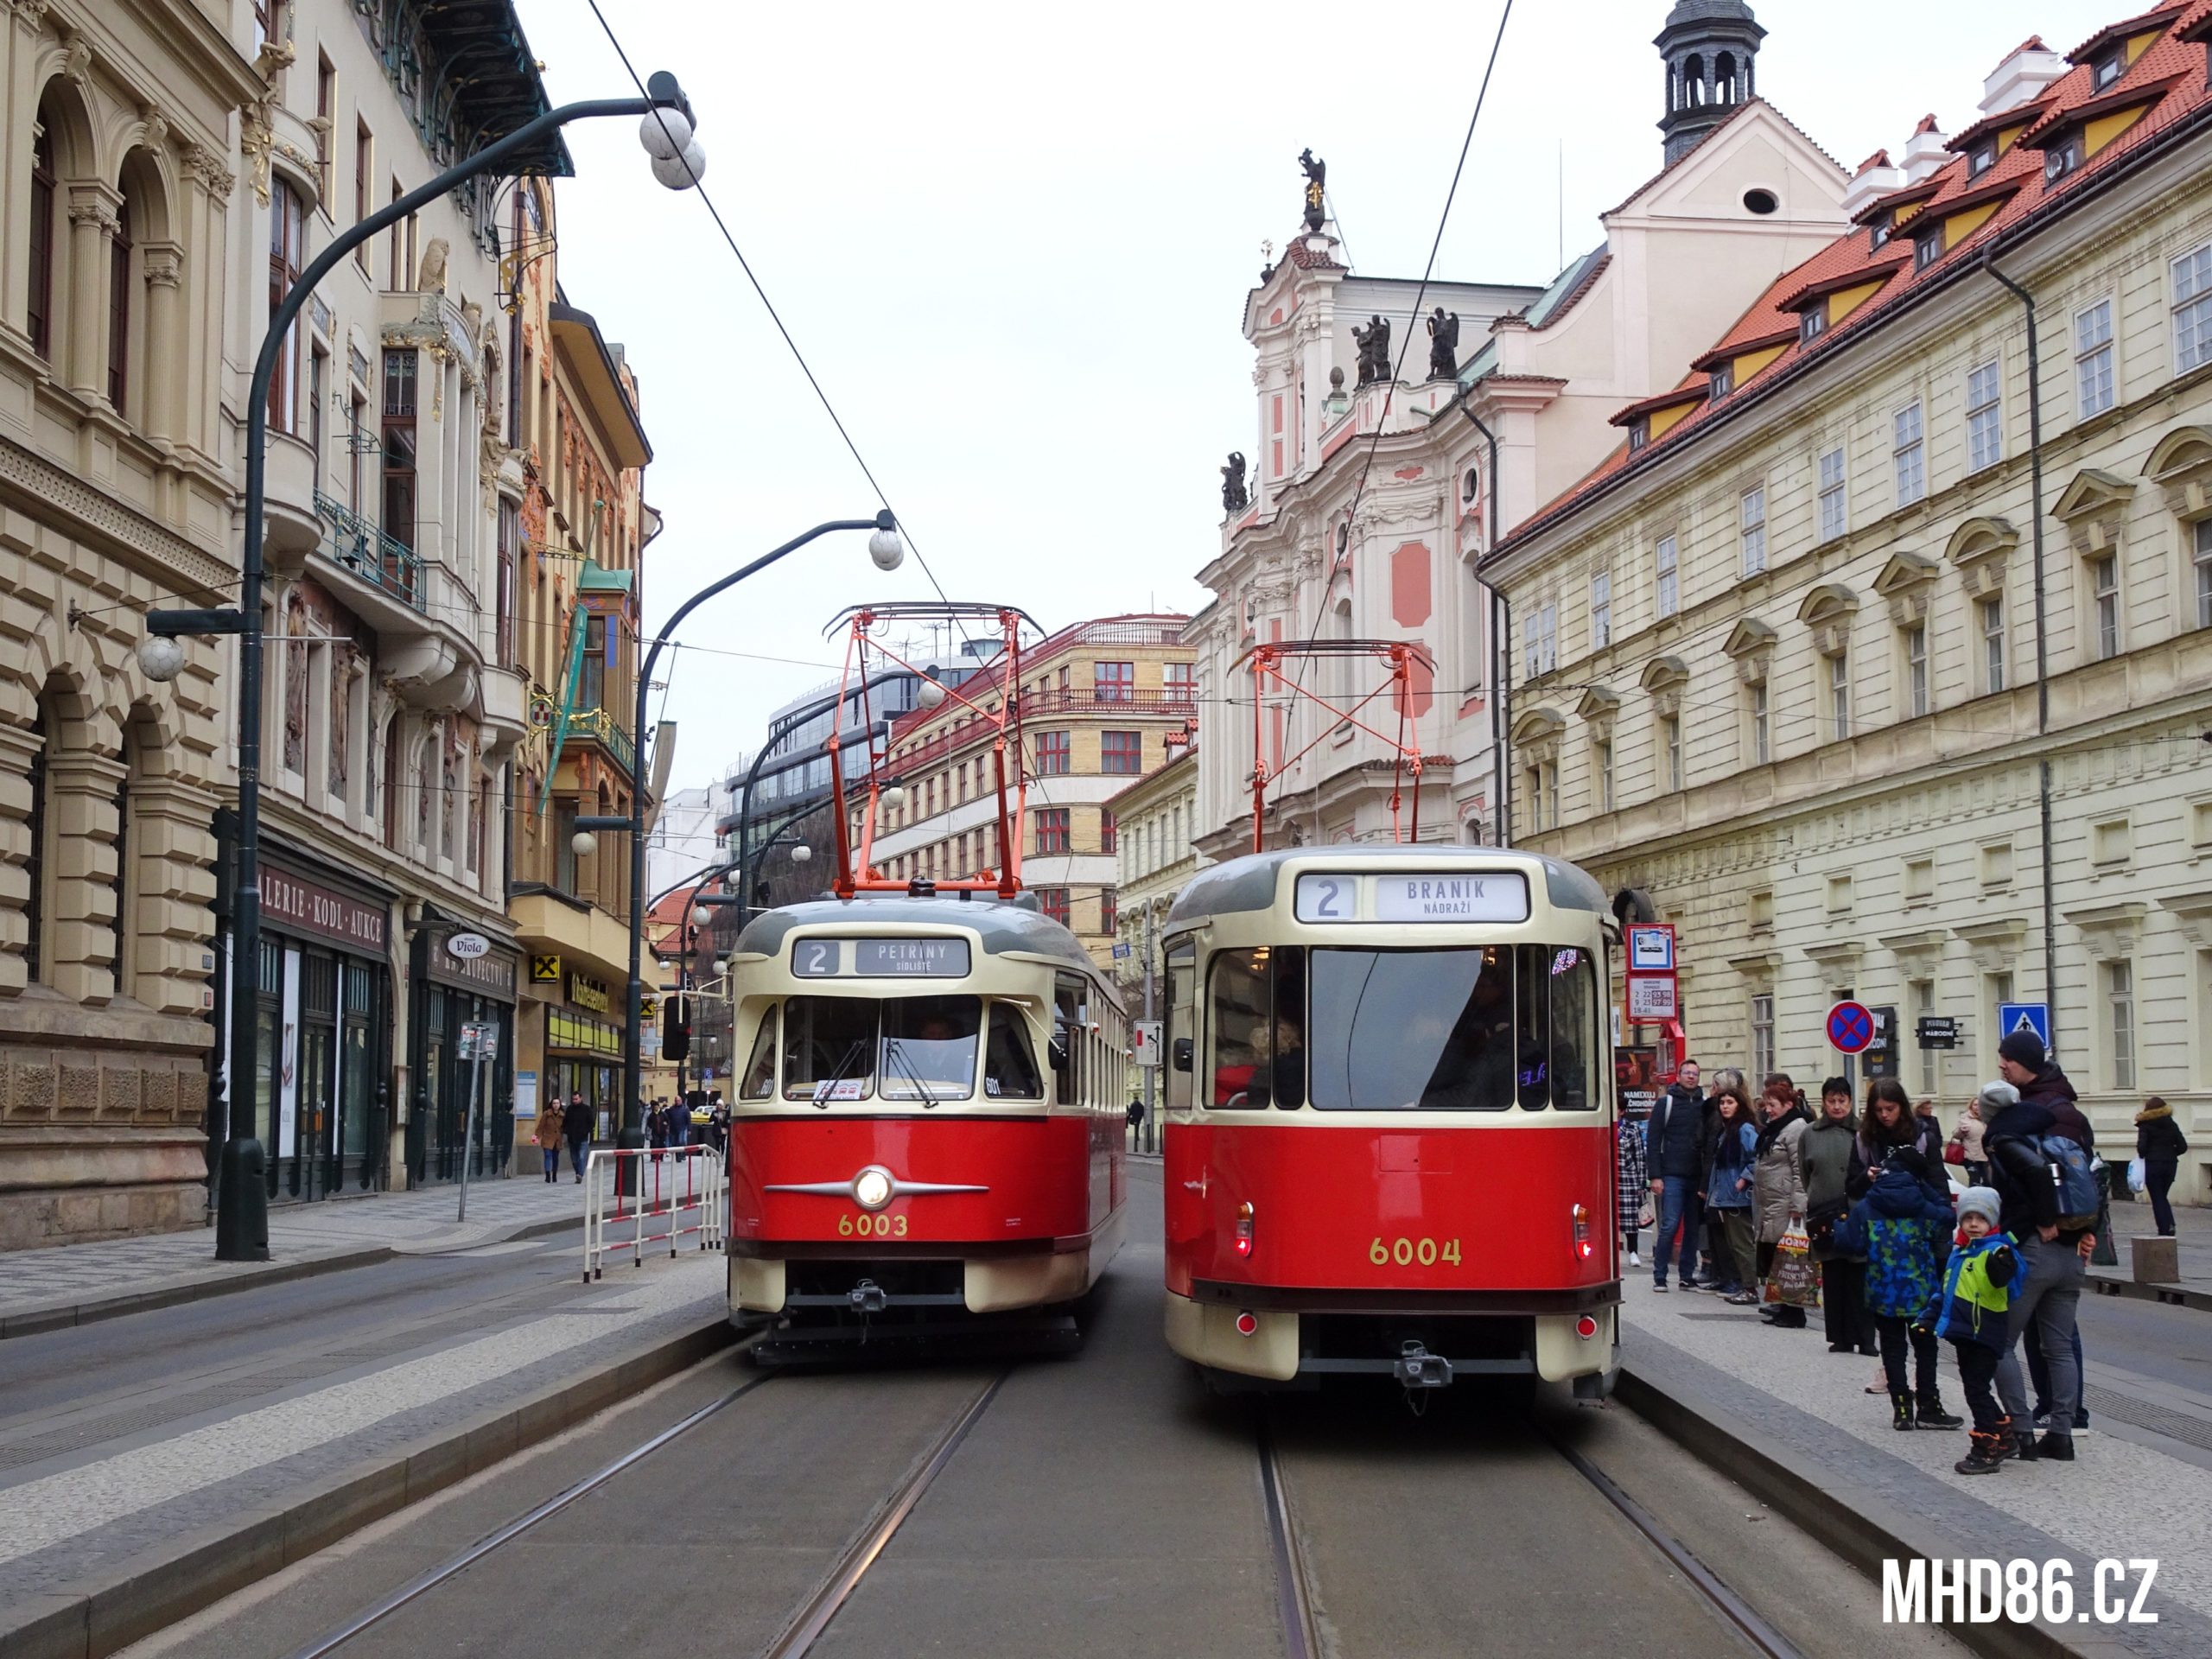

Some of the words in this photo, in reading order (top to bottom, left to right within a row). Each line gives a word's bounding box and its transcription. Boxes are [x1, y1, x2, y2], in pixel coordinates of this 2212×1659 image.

[1318, 880, 1338, 917] 2
[1407, 877, 1485, 899] BRANÍK
[1423, 900, 1471, 914] NÁDRAŽÍ
[257, 874, 305, 918] ALERIE
[314, 894, 343, 931] KODL
[350, 909, 381, 943] AUKCE
[456, 940, 482, 953] Viola
[809, 944, 827, 972] 2
[878, 942, 947, 959] PETŘINY
[1925, 1028, 1954, 1037] NÁRODNÍ
[985, 1077, 1001, 1095] 601
[838, 1214, 907, 1236] 6003
[1370, 1237, 1462, 1267] 6004
